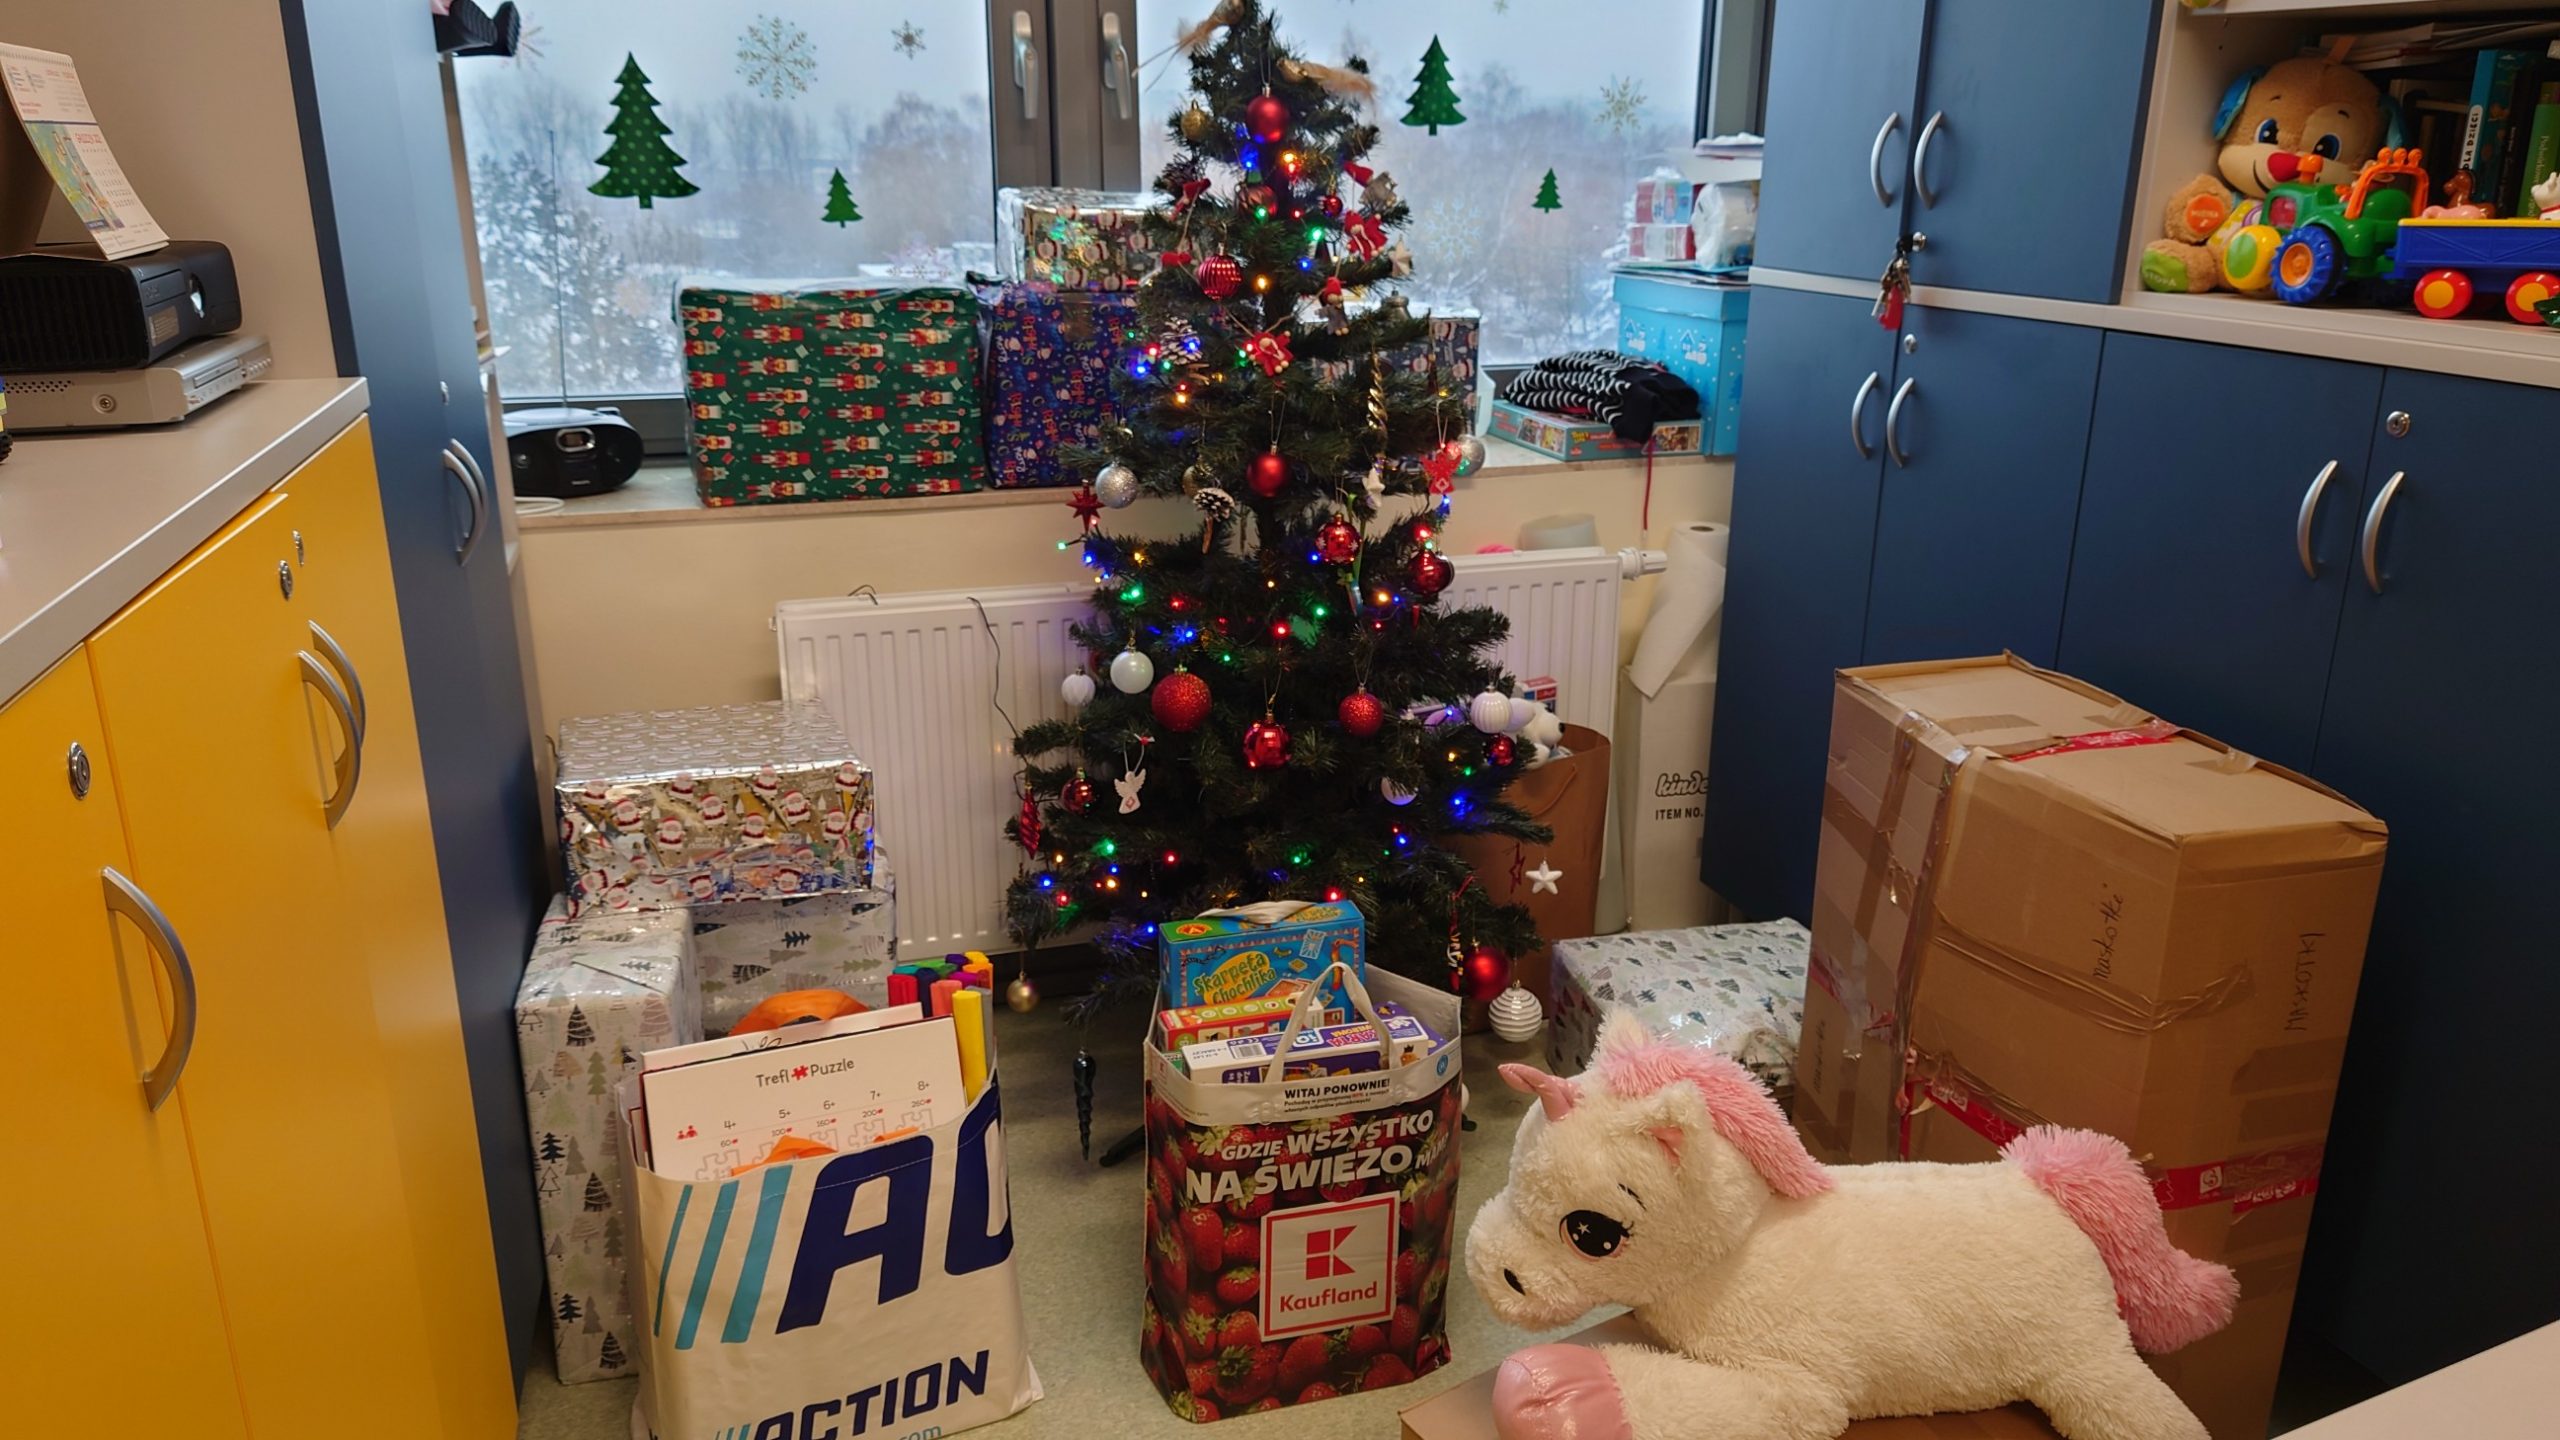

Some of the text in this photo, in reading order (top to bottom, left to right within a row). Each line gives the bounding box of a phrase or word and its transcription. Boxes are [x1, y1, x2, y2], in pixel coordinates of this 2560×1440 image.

[2466, 112, 2479, 147] DZIECI
[1655, 807, 1704, 820] ITEM NO.
[1192, 953, 1266, 996] Skarpeta
[1212, 967, 1277, 1004] Chochlika
[2284, 933, 2326, 1031] MASKOTKI
[756, 1058, 855, 1087] Trefl Puzzle
[1284, 1078, 1391, 1099] WITAJ PONOWNIE!
[723, 1080, 930, 1129] 4+ 5+ 6+ 7+ 8+
[1221, 1109, 1434, 1162] GDZIE WSZYSTKO
[1186, 1168, 1243, 1204] NA
[1253, 1140, 1413, 1195] ŚWIEŻO
[1279, 1281, 1378, 1313] Kaufland
[753, 1349, 990, 1440] ACTION
